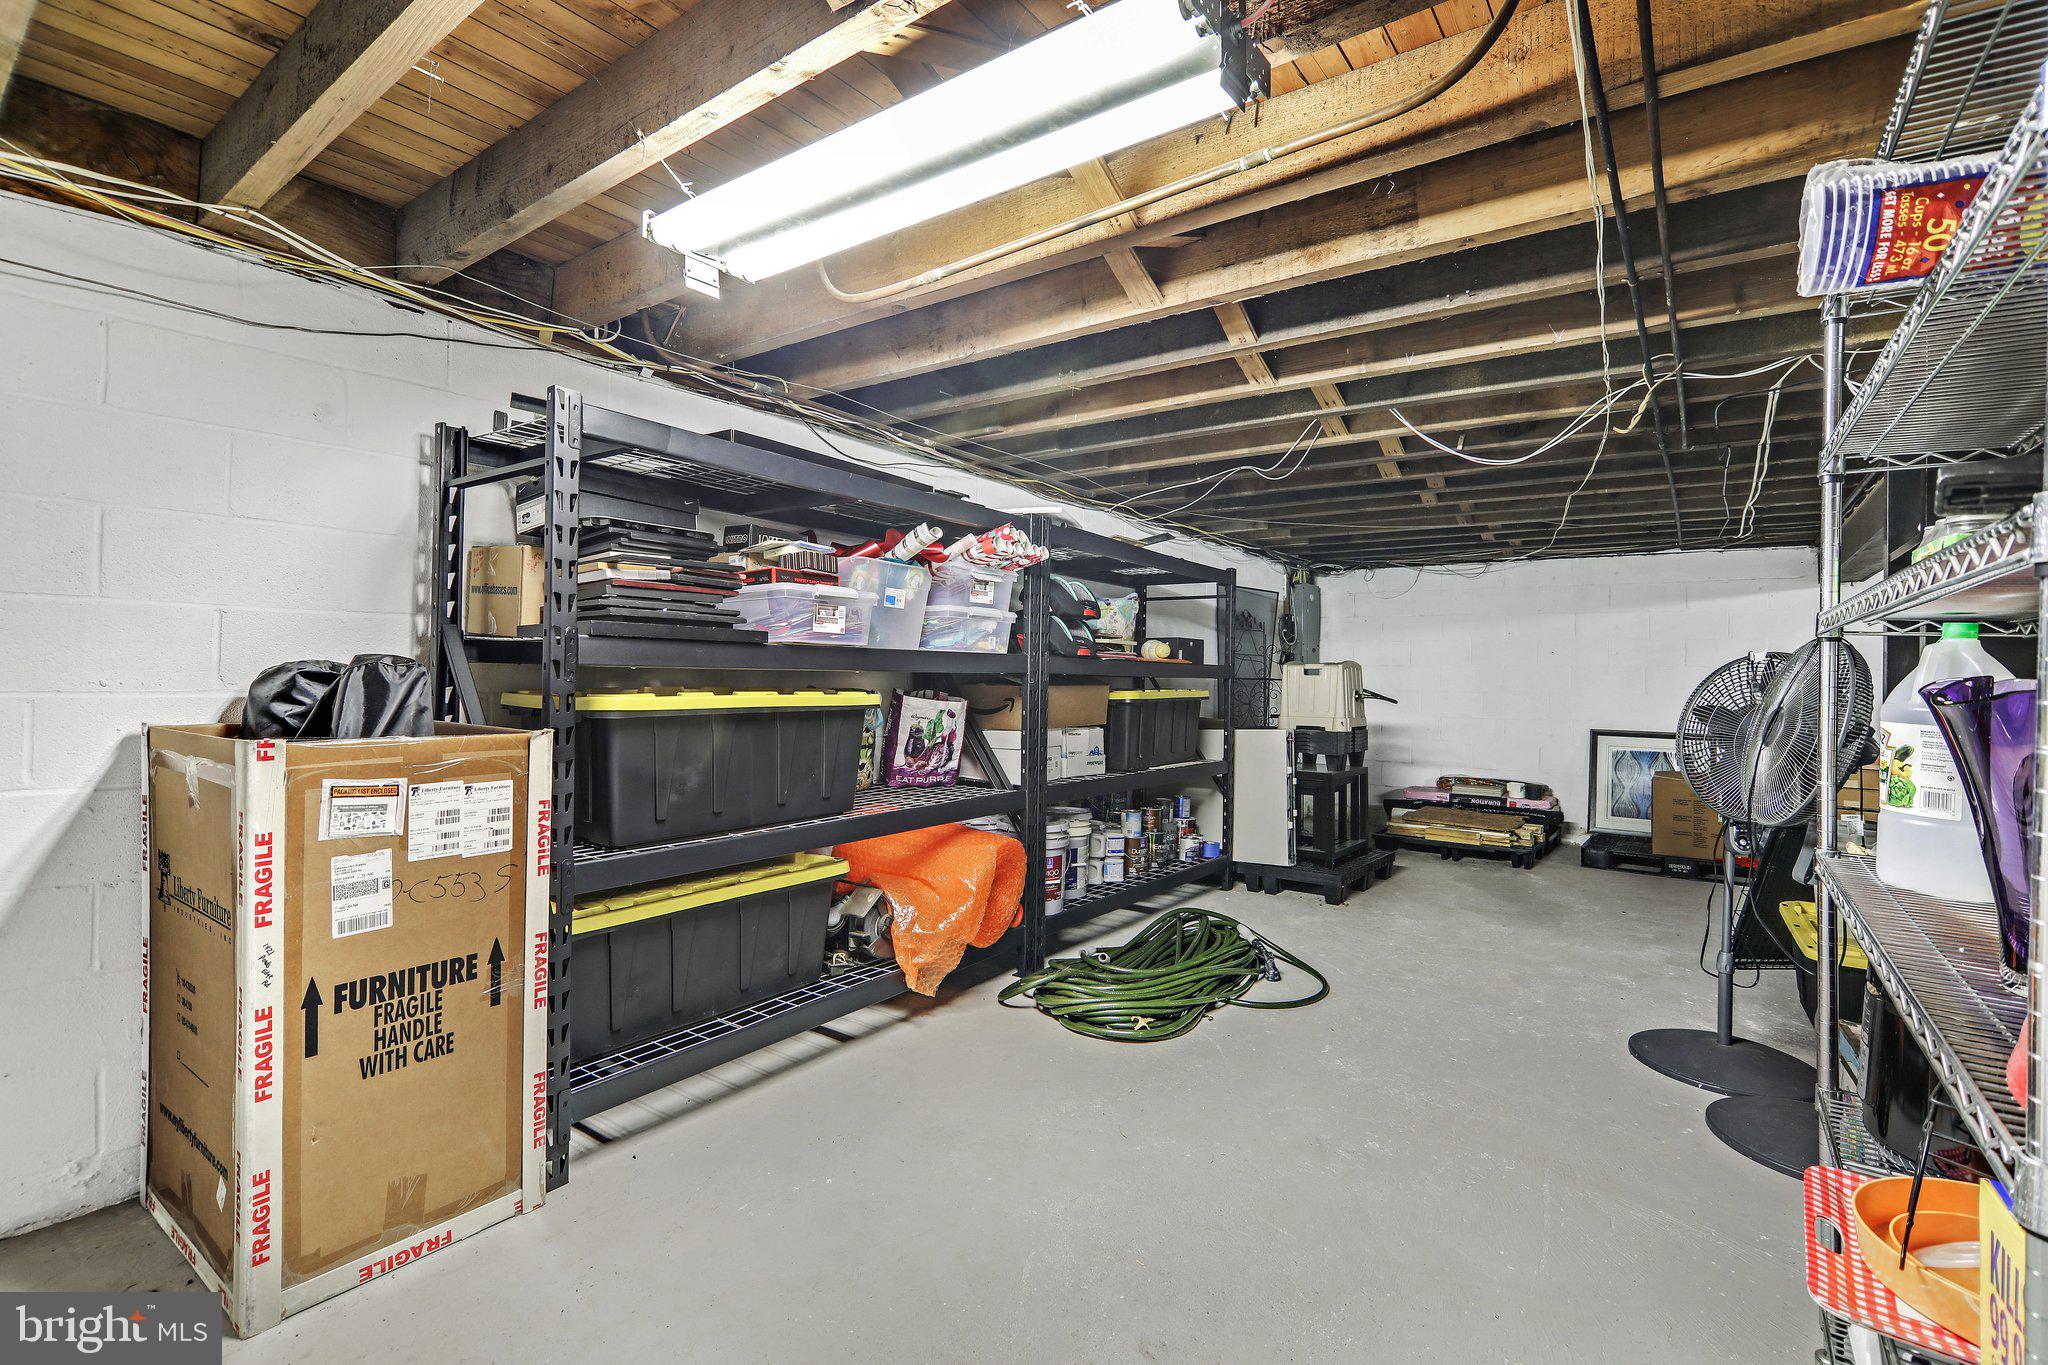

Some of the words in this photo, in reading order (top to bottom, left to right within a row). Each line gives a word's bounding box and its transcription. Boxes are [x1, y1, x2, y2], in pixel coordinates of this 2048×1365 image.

[1884, 190, 1897, 206] GET
[1897, 191, 1915, 228] Tasses
[1909, 197, 1930, 228] Cups
[1880, 209, 1896, 239] MORE
[1923, 218, 1957, 252] 50
[1875, 241, 1891, 262] FOR
[1889, 239, 1907, 263] 473
[1901, 258, 1913, 271] oz
[1905, 240, 1922, 255] 16
[895, 775, 916, 784] EAT
[1471, 798, 1501, 806] DURATION
[537, 800, 550, 877] FRAGILE
[254, 831, 273, 929] FRAGILE
[173, 875, 197, 913] Liberty
[197, 887, 232, 928] Furniture
[333, 953, 478, 1014] FURNITURE
[533, 931, 548, 1010] FRAGILE
[374, 989, 443, 1028] FRAGILE
[374, 1012, 443, 1052] HANDLE
[254, 1005, 273, 1104] FRAGILE
[358, 1045, 408, 1081] WITH
[413, 1031, 455, 1064] CARE
[533, 1070, 547, 1150] FRAGILE
[252, 1169, 271, 1268] FRAGILE
[171, 1226, 196, 1267] FRAGILE
[359, 1229, 453, 1284] FRAGILE
